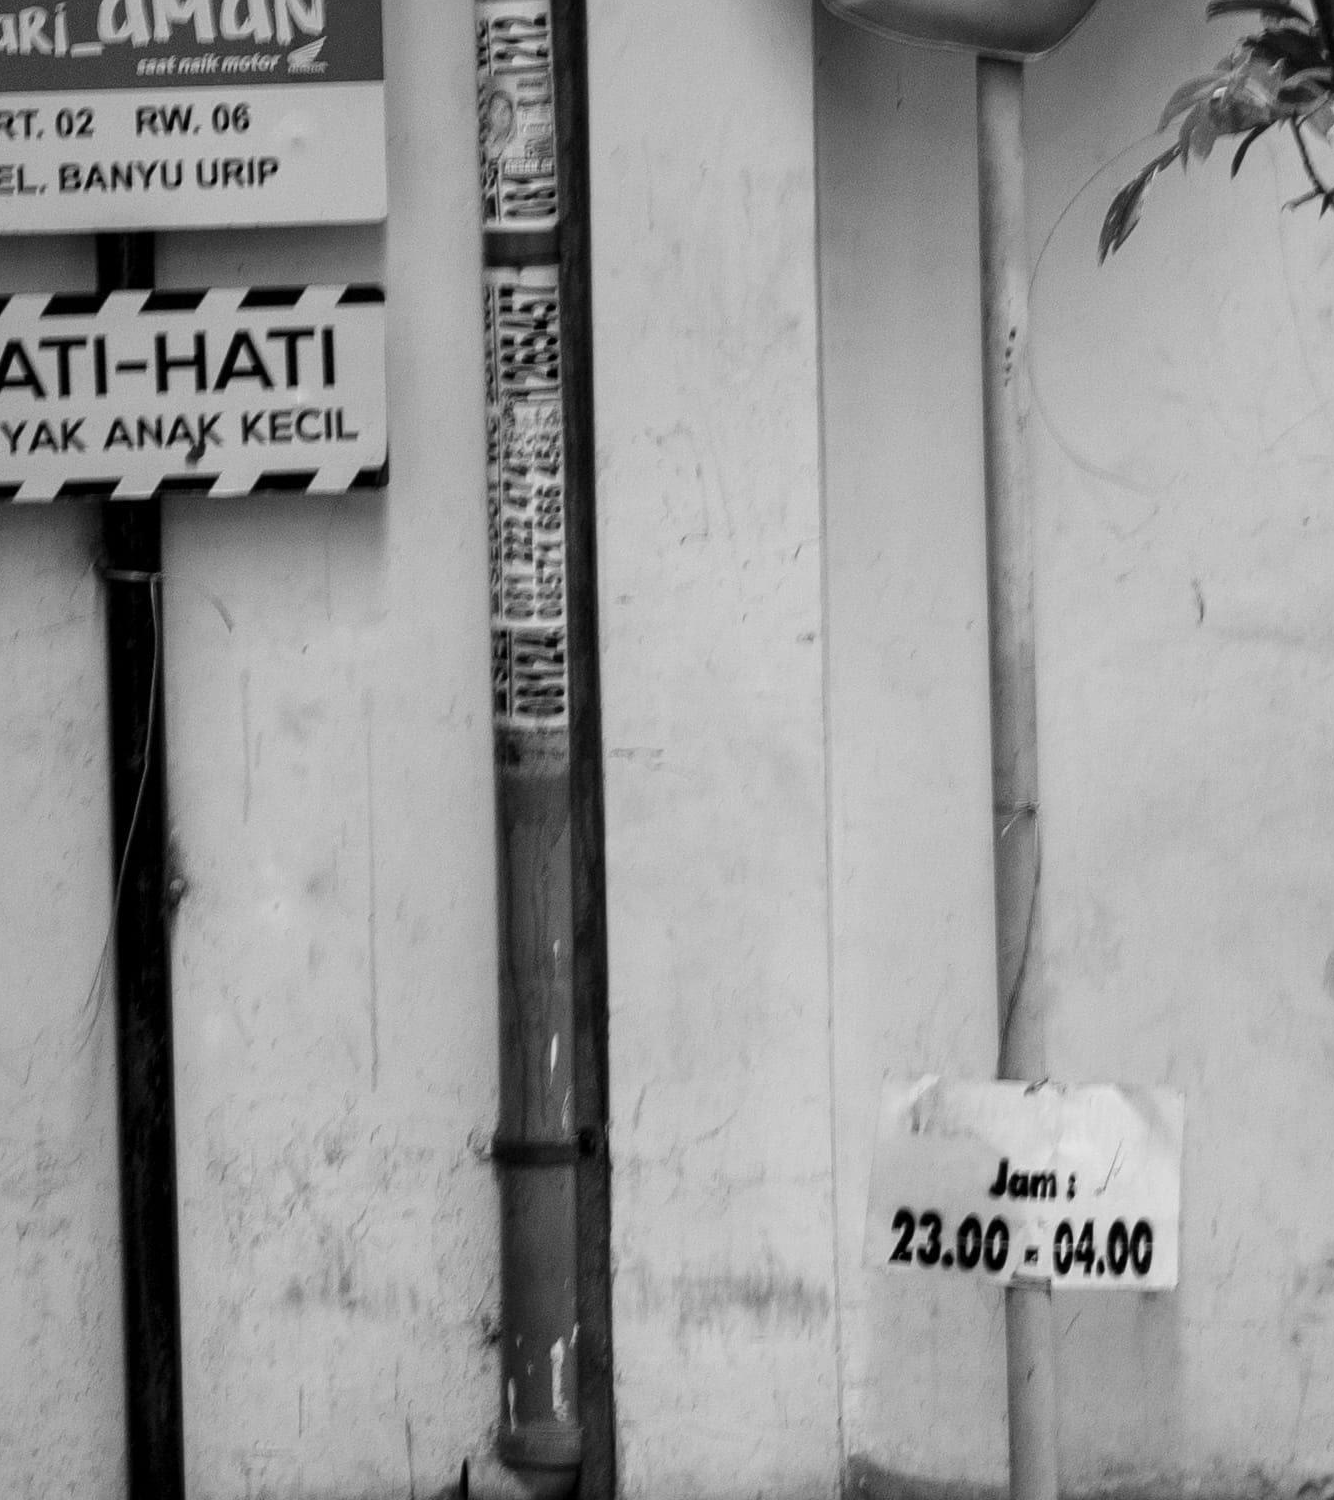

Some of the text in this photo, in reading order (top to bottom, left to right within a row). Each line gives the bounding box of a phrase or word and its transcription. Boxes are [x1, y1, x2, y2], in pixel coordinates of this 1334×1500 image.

[178, 52, 220, 75] naik
[221, 52, 282, 73] motor
[55, 107, 95, 138] 02
[135, 103, 200, 136] RW.
[211, 102, 251, 134] 06
[59, 158, 183, 194] BANYU
[195, 156, 281, 189] URIP
[103, 412, 224, 452] ANAK
[240, 407, 359, 445] KECIL
[989, 1156, 1057, 1199] Jam
[887, 1206, 1010, 1273] 23.00
[1053, 1217, 1154, 1278] 04.00
